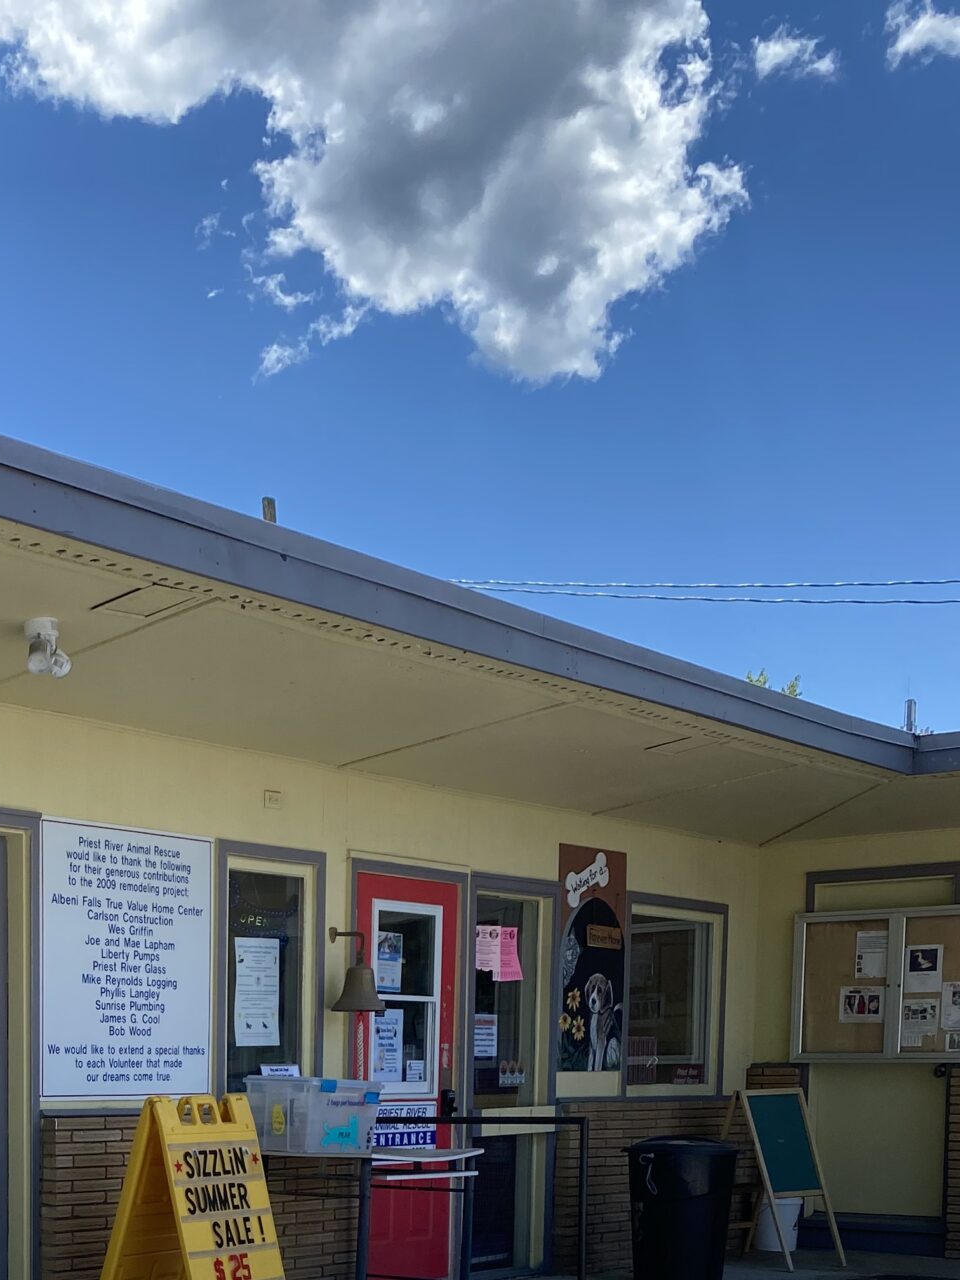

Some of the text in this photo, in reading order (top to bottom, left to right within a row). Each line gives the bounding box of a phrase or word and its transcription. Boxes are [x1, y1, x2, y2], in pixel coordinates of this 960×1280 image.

[79, 837, 180, 858] Priest River Animal Rescue
[66, 851, 191, 875] would like to thank the following
[70, 862, 189, 884] for their generous contributions
[69, 875, 76, 886] to
[81, 876, 92, 887] the
[97, 879, 116, 889] 2009
[120, 883, 159, 896] remodeling
[52, 893, 203, 916] Albeni Falls True Value Home Center
[88, 909, 173, 926] Carlson Construction
[108, 924, 153, 936] Wes Griffin
[85, 935, 175, 951] Joe and Mae Lapham
[101, 949, 159, 962] Liberty Pumps
[93, 961, 166, 974] Priest River Glass
[82, 974, 177, 989] Mike Reynolds Logging
[101, 987, 160, 1000] Phyllis Langley
[95, 1000, 165, 1013] Sunrise Plumbing
[100, 1013, 126, 1023] James
[142, 1014, 160, 1024] Cool
[109, 1026, 151, 1036] Bob Wood
[48, 1044, 60, 1054] We
[64, 1044, 87, 1054] would
[91, 1044, 104, 1054] like
[108, 1045, 115, 1054] to
[119, 1044, 144, 1055] extend
[155, 1046, 179, 1056] special
[183, 1046, 205, 1055] thanks
[76, 1058, 182, 1068] to each Volunteer that made
[87, 1074, 99, 1082] our
[103, 1072, 130, 1082] dreams
[378, 1108, 427, 1117] PRIEST RIVER
[372, 1132, 431, 1146] ENTRANCE
[185, 1183, 250, 1215] SUMMER
